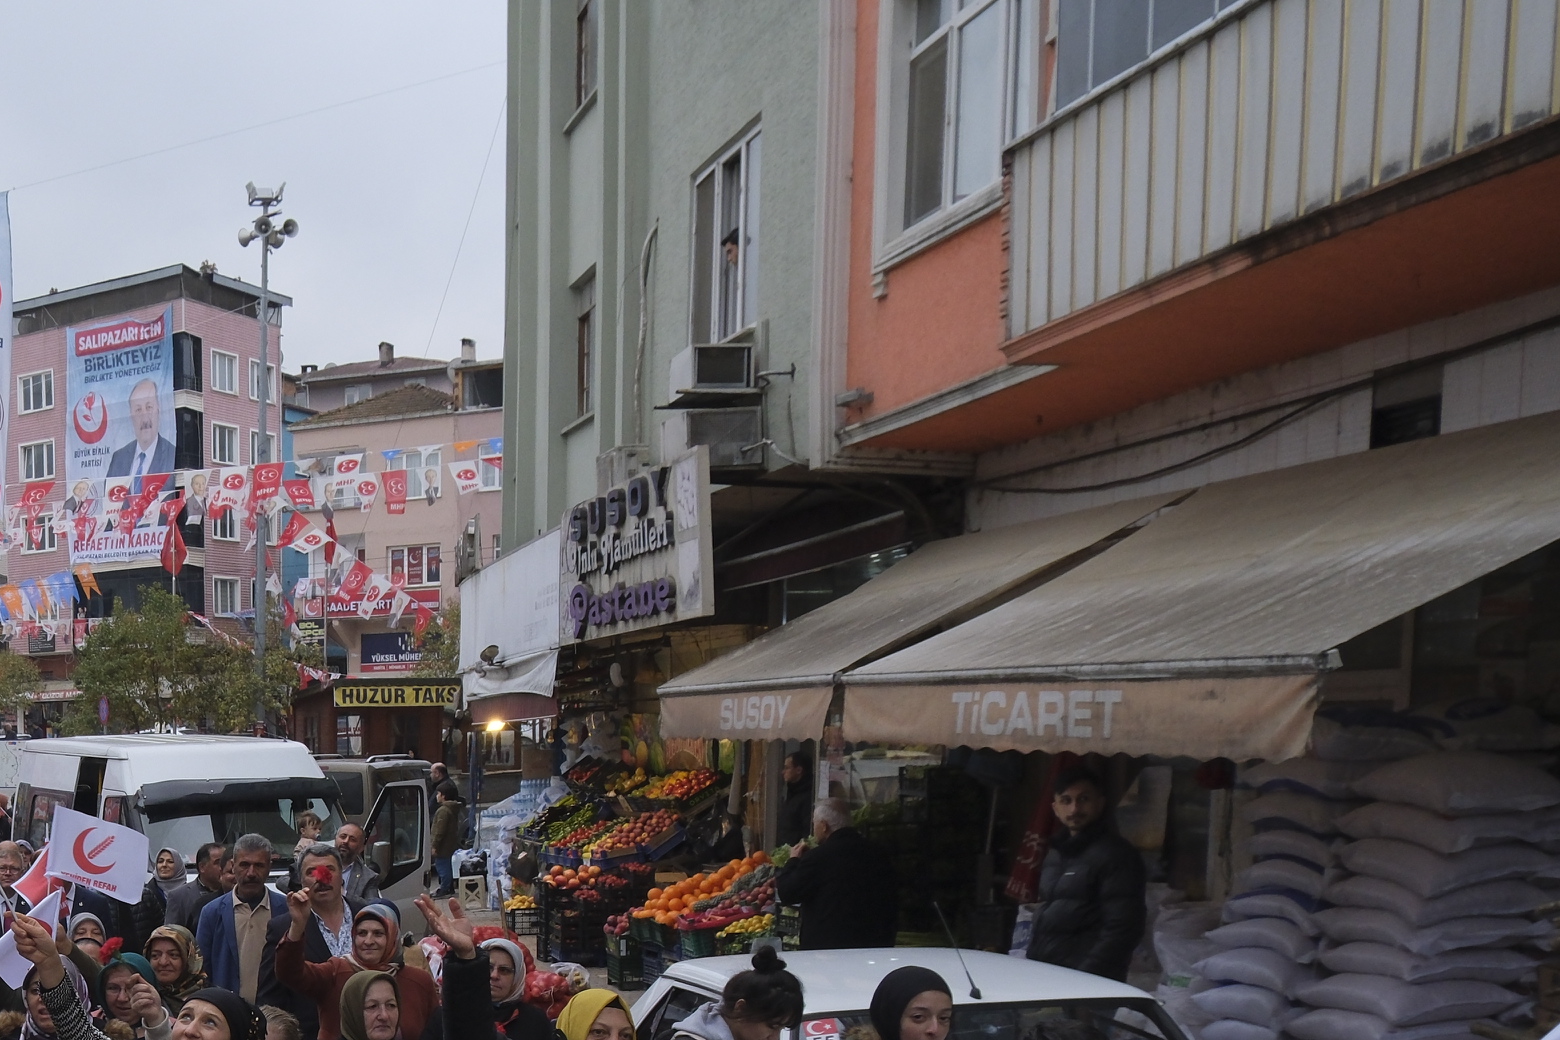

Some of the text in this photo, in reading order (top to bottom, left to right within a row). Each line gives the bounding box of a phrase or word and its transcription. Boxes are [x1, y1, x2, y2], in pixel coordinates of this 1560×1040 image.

[78, 321, 161, 350] SALIPAZARI İÇİN
[84, 345, 161, 373] BİRLİKTEYİZ
[81, 458, 102, 468] PARTİSİ
[256, 487, 276, 496] MHP
[336, 478, 355, 486] MHP
[570, 467, 672, 541] SUSOY
[570, 577, 674, 639] Pastane
[372, 652, 397, 662] YÜKSEL
[342, 688, 406, 704] HUZUR
[719, 695, 791, 731] SUSOY
[952, 689, 1122, 739] TİCARET
[93, 879, 118, 892] REFAH
